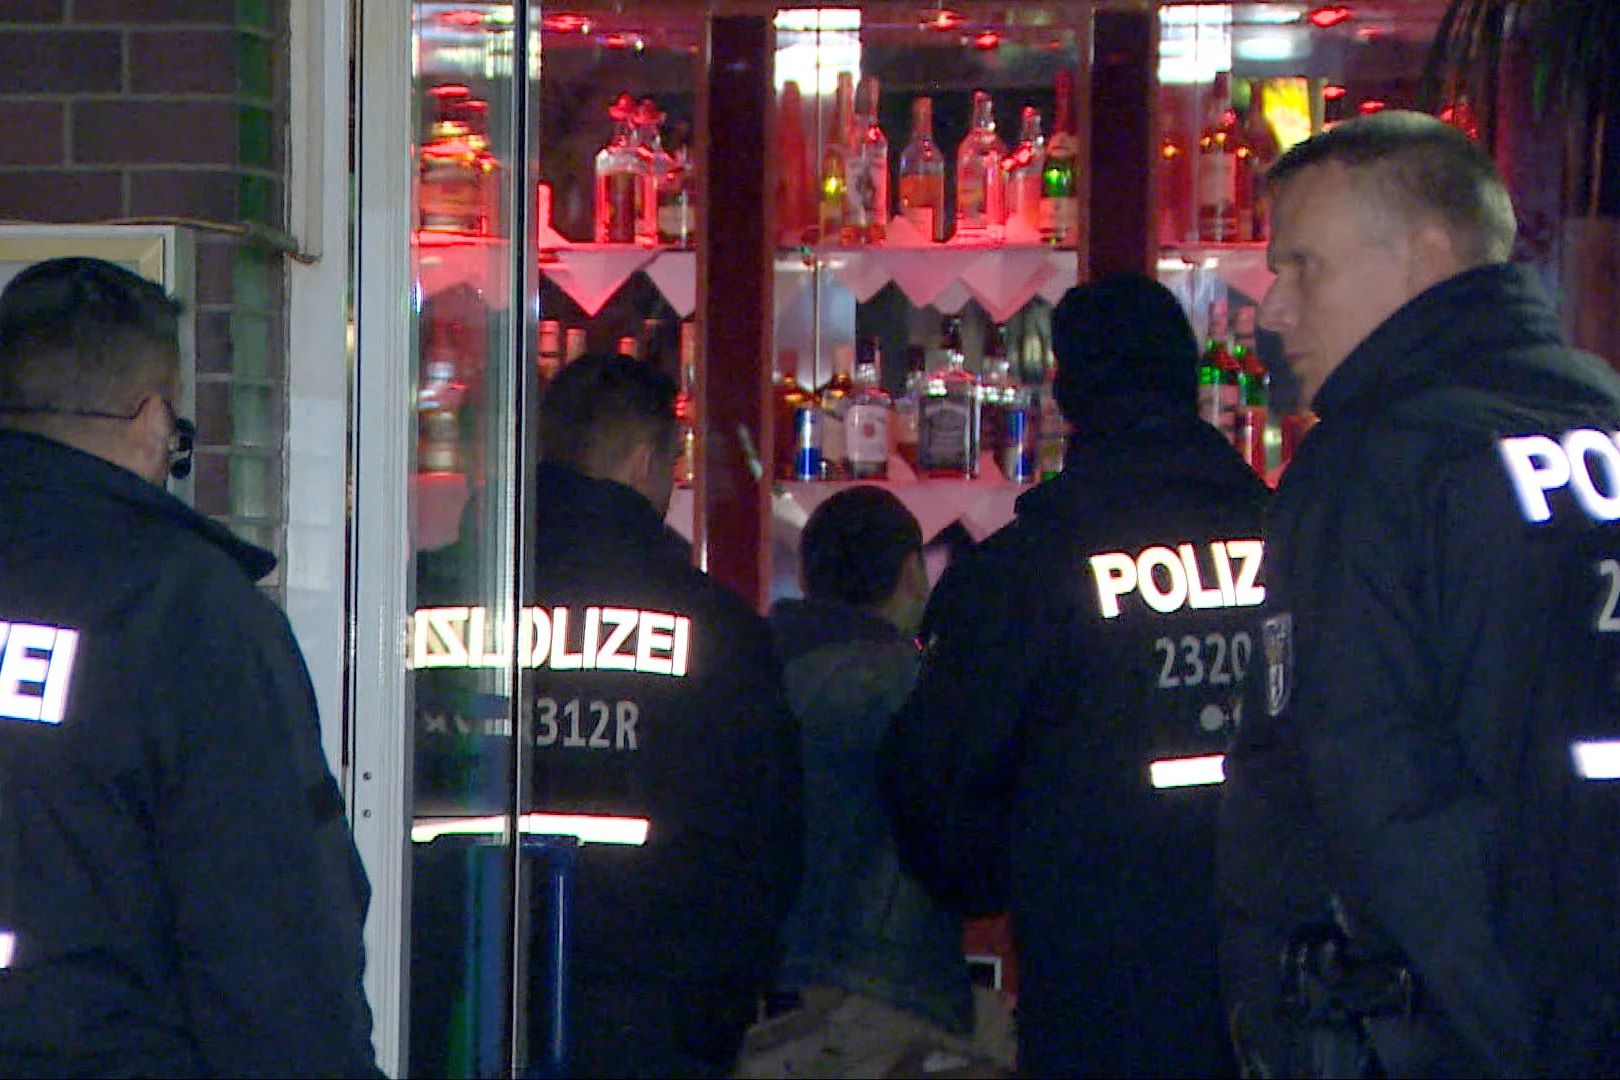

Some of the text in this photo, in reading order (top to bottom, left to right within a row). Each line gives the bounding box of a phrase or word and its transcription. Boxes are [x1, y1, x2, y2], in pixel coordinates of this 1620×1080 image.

[1499, 426, 1620, 523] PO
[1090, 540, 1266, 618] POLIZ
[0, 621, 80, 723] EI
